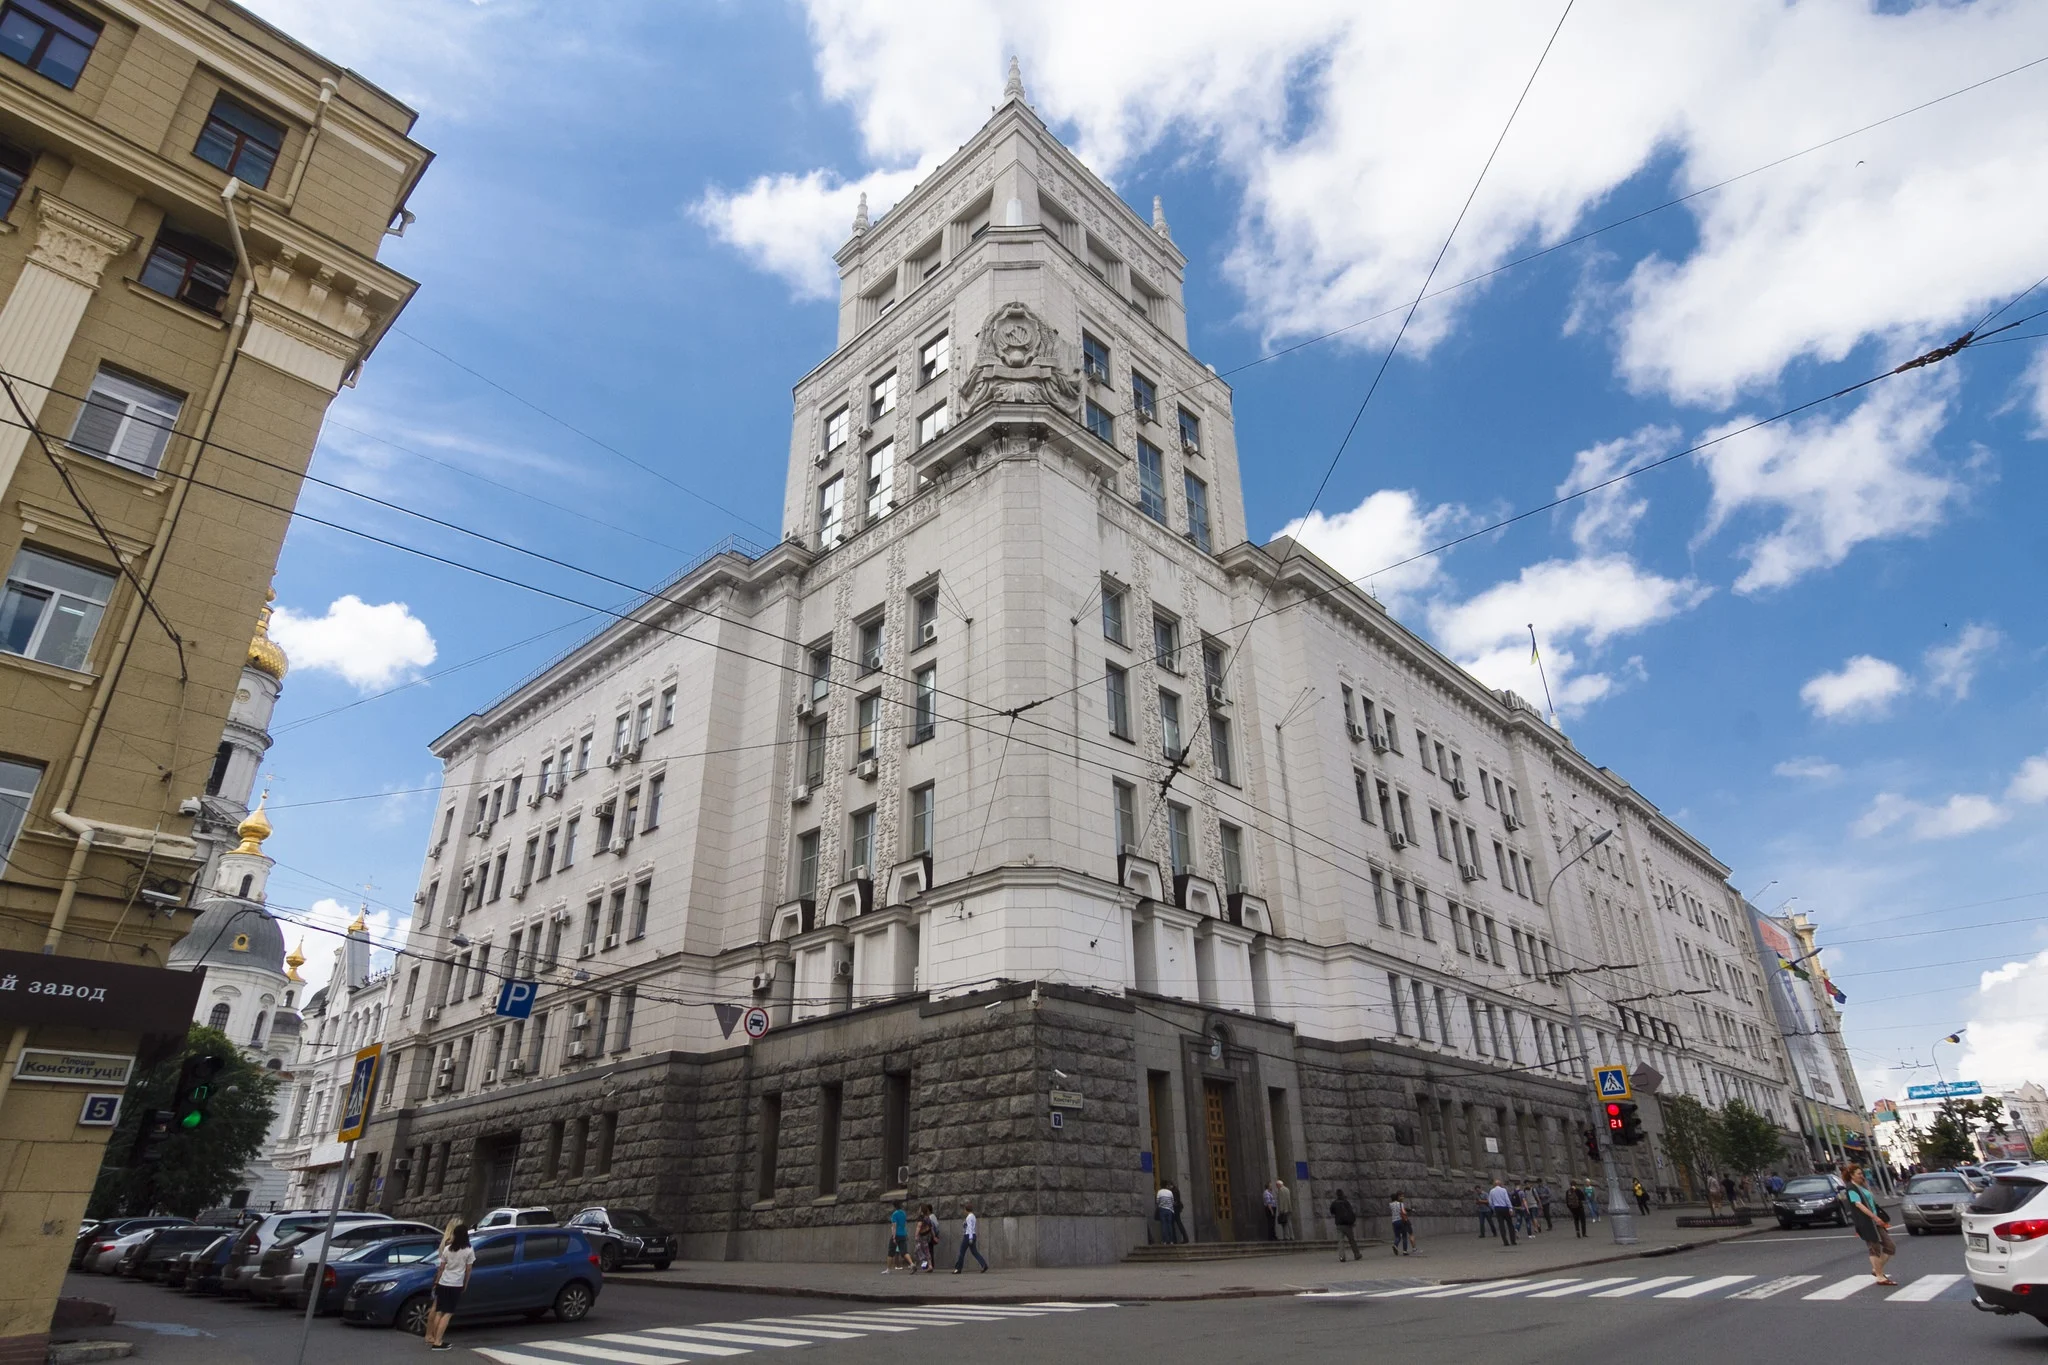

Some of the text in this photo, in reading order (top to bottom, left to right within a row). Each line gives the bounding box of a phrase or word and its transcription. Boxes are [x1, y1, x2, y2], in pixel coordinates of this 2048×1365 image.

[28, 981, 107, 1002] завод
[505, 982, 530, 1011] P
[61, 1056, 96, 1066] Площа
[25, 1062, 123, 1077] Конституції
[92, 1101, 109, 1118] 5
[1610, 1119, 1622, 1128] 21
